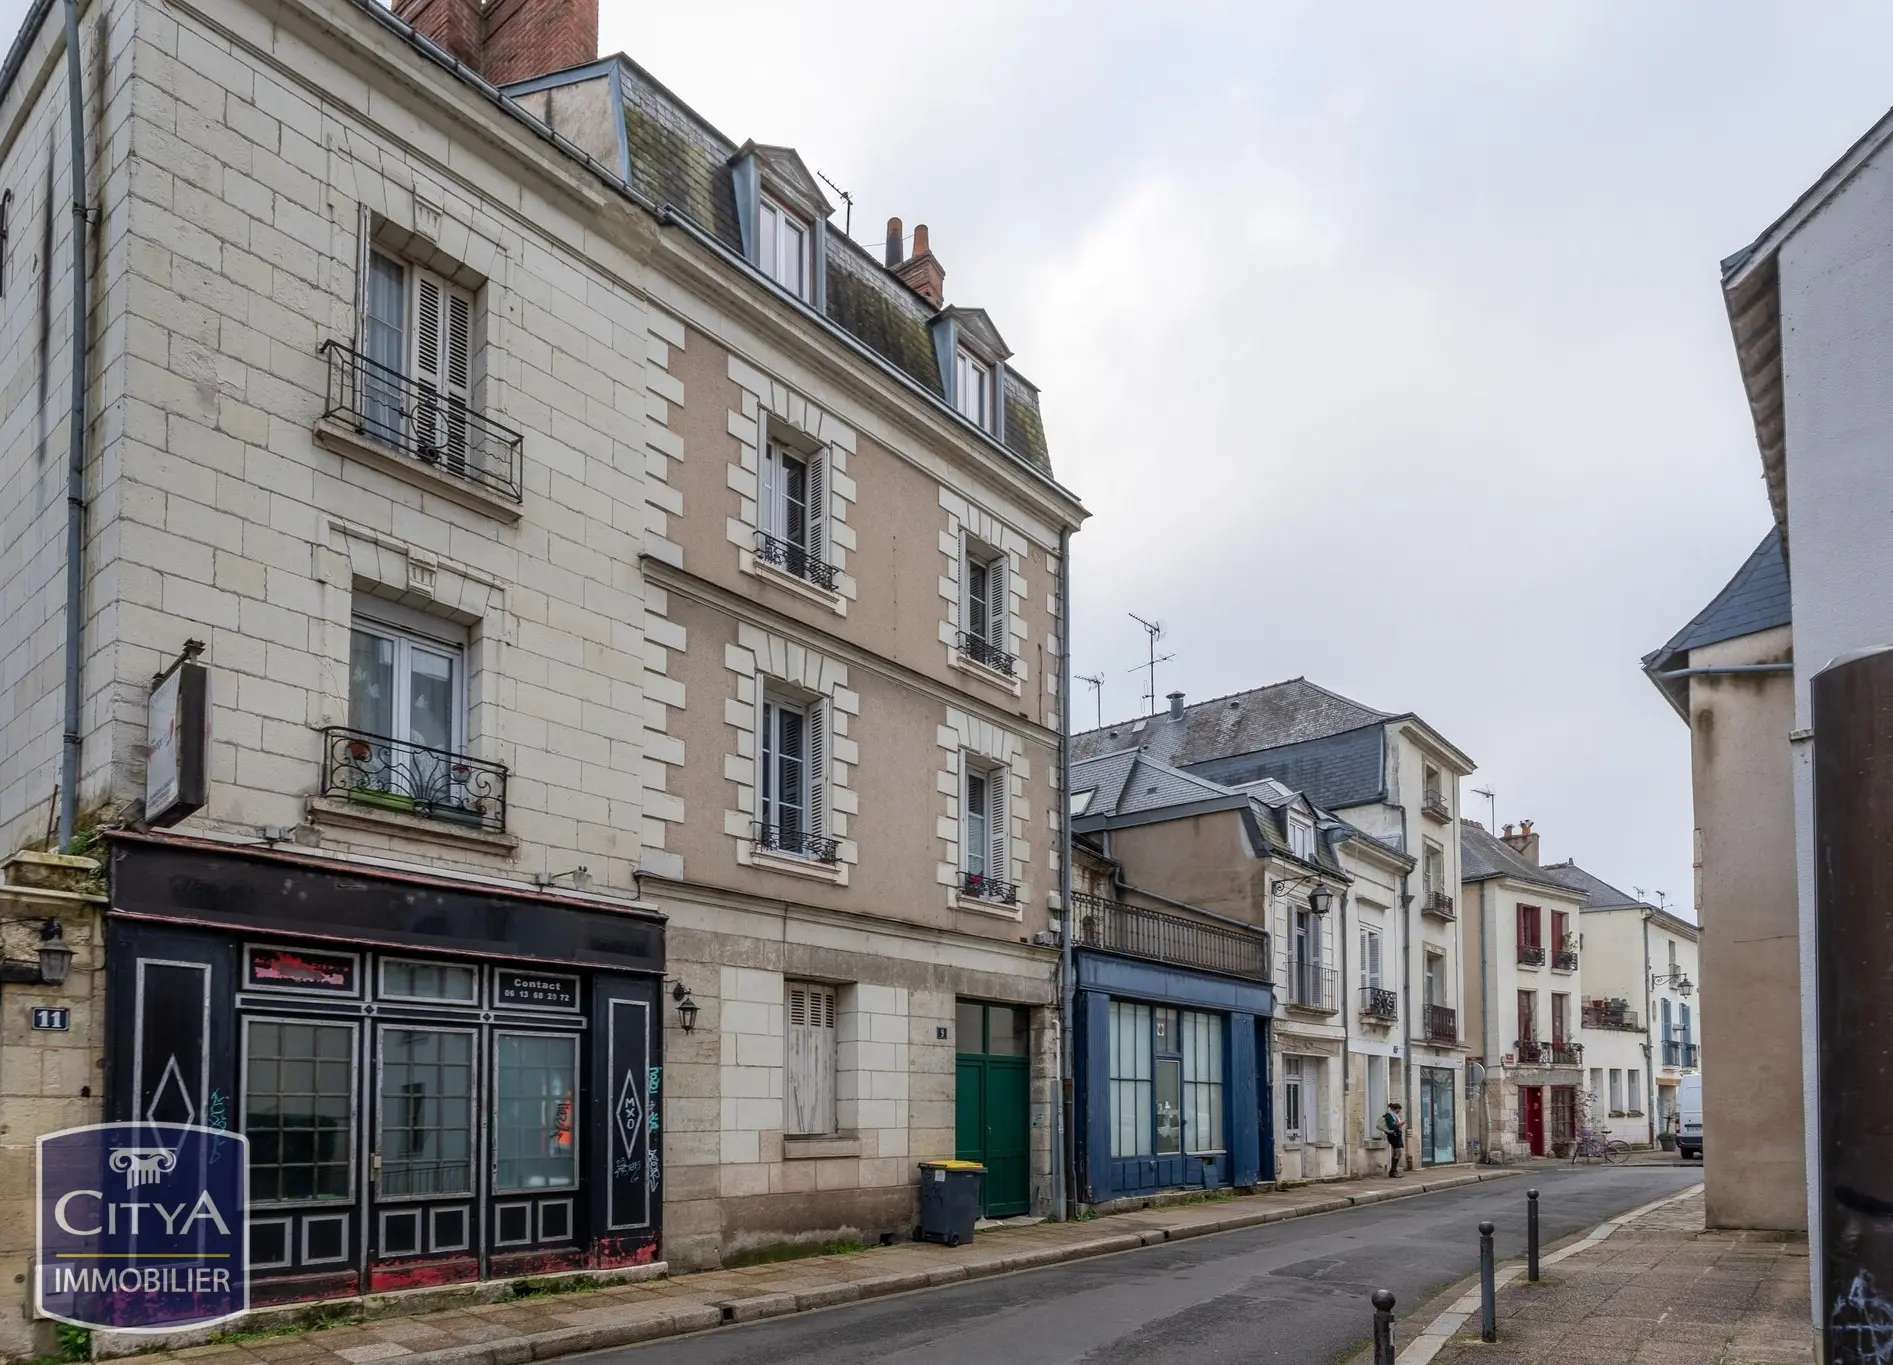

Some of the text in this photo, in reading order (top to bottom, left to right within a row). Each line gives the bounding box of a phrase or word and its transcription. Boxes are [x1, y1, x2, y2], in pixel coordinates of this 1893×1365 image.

[514, 978, 561, 991] Contact
[504, 989, 515, 997] 06
[519, 990, 529, 998] 13
[560, 994, 570, 1002] 72
[38, 1010, 62, 1028] 11
